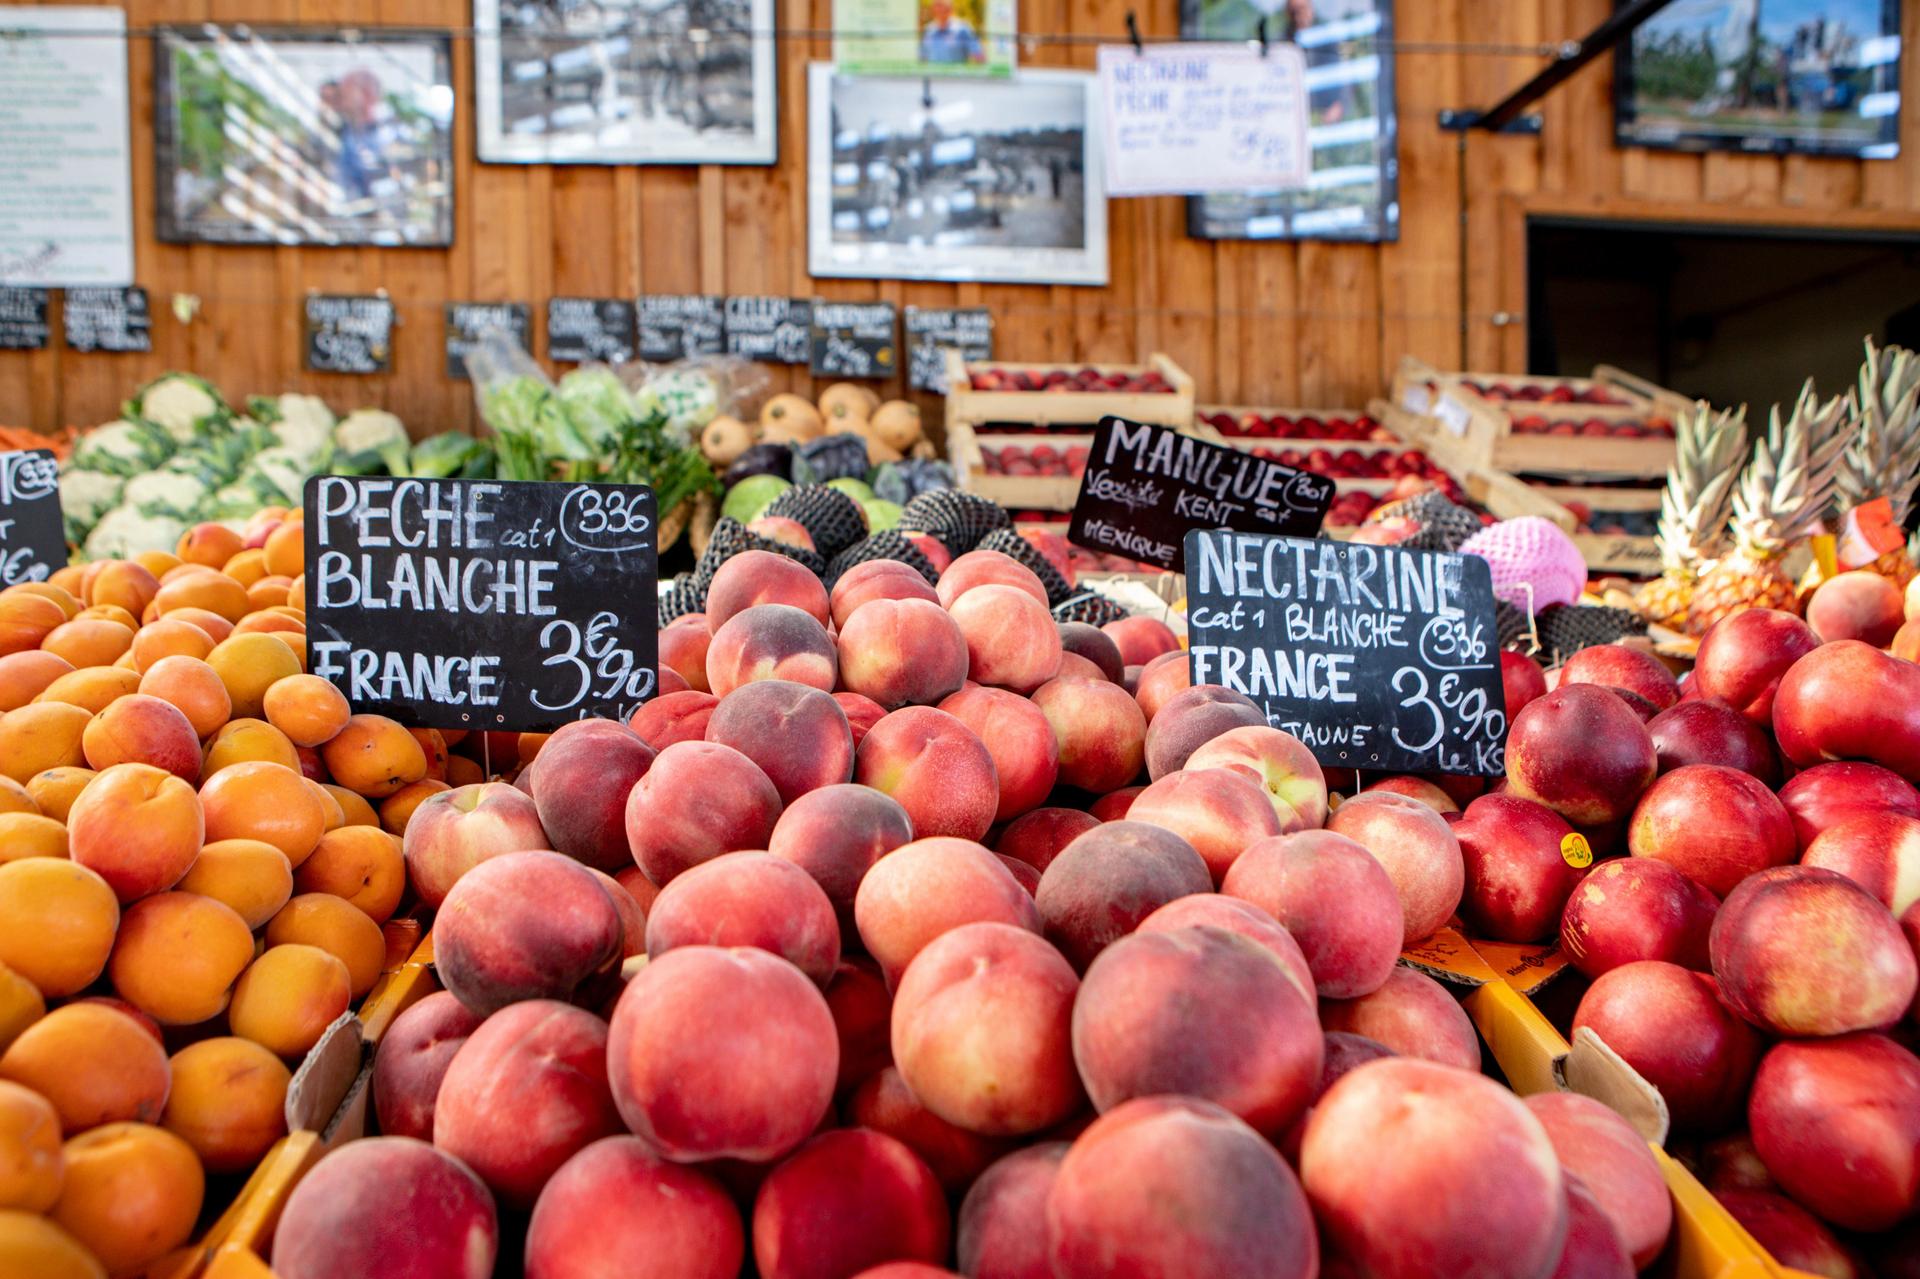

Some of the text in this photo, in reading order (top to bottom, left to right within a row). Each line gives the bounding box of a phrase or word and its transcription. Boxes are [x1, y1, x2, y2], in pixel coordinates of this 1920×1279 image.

[1105, 419, 1297, 509] MANGUE
[317, 477, 502, 548] PECHE
[578, 489, 650, 534] 336
[1174, 488, 1246, 526] KENT
[317, 552, 559, 615] BLANCHE
[1198, 531, 1466, 617] NECTARINE
[1286, 603, 1409, 648] BLANCHE
[1432, 621, 1488, 664] 336
[313, 641, 500, 705] FRANCE
[1192, 646, 1358, 703] FRANCE
